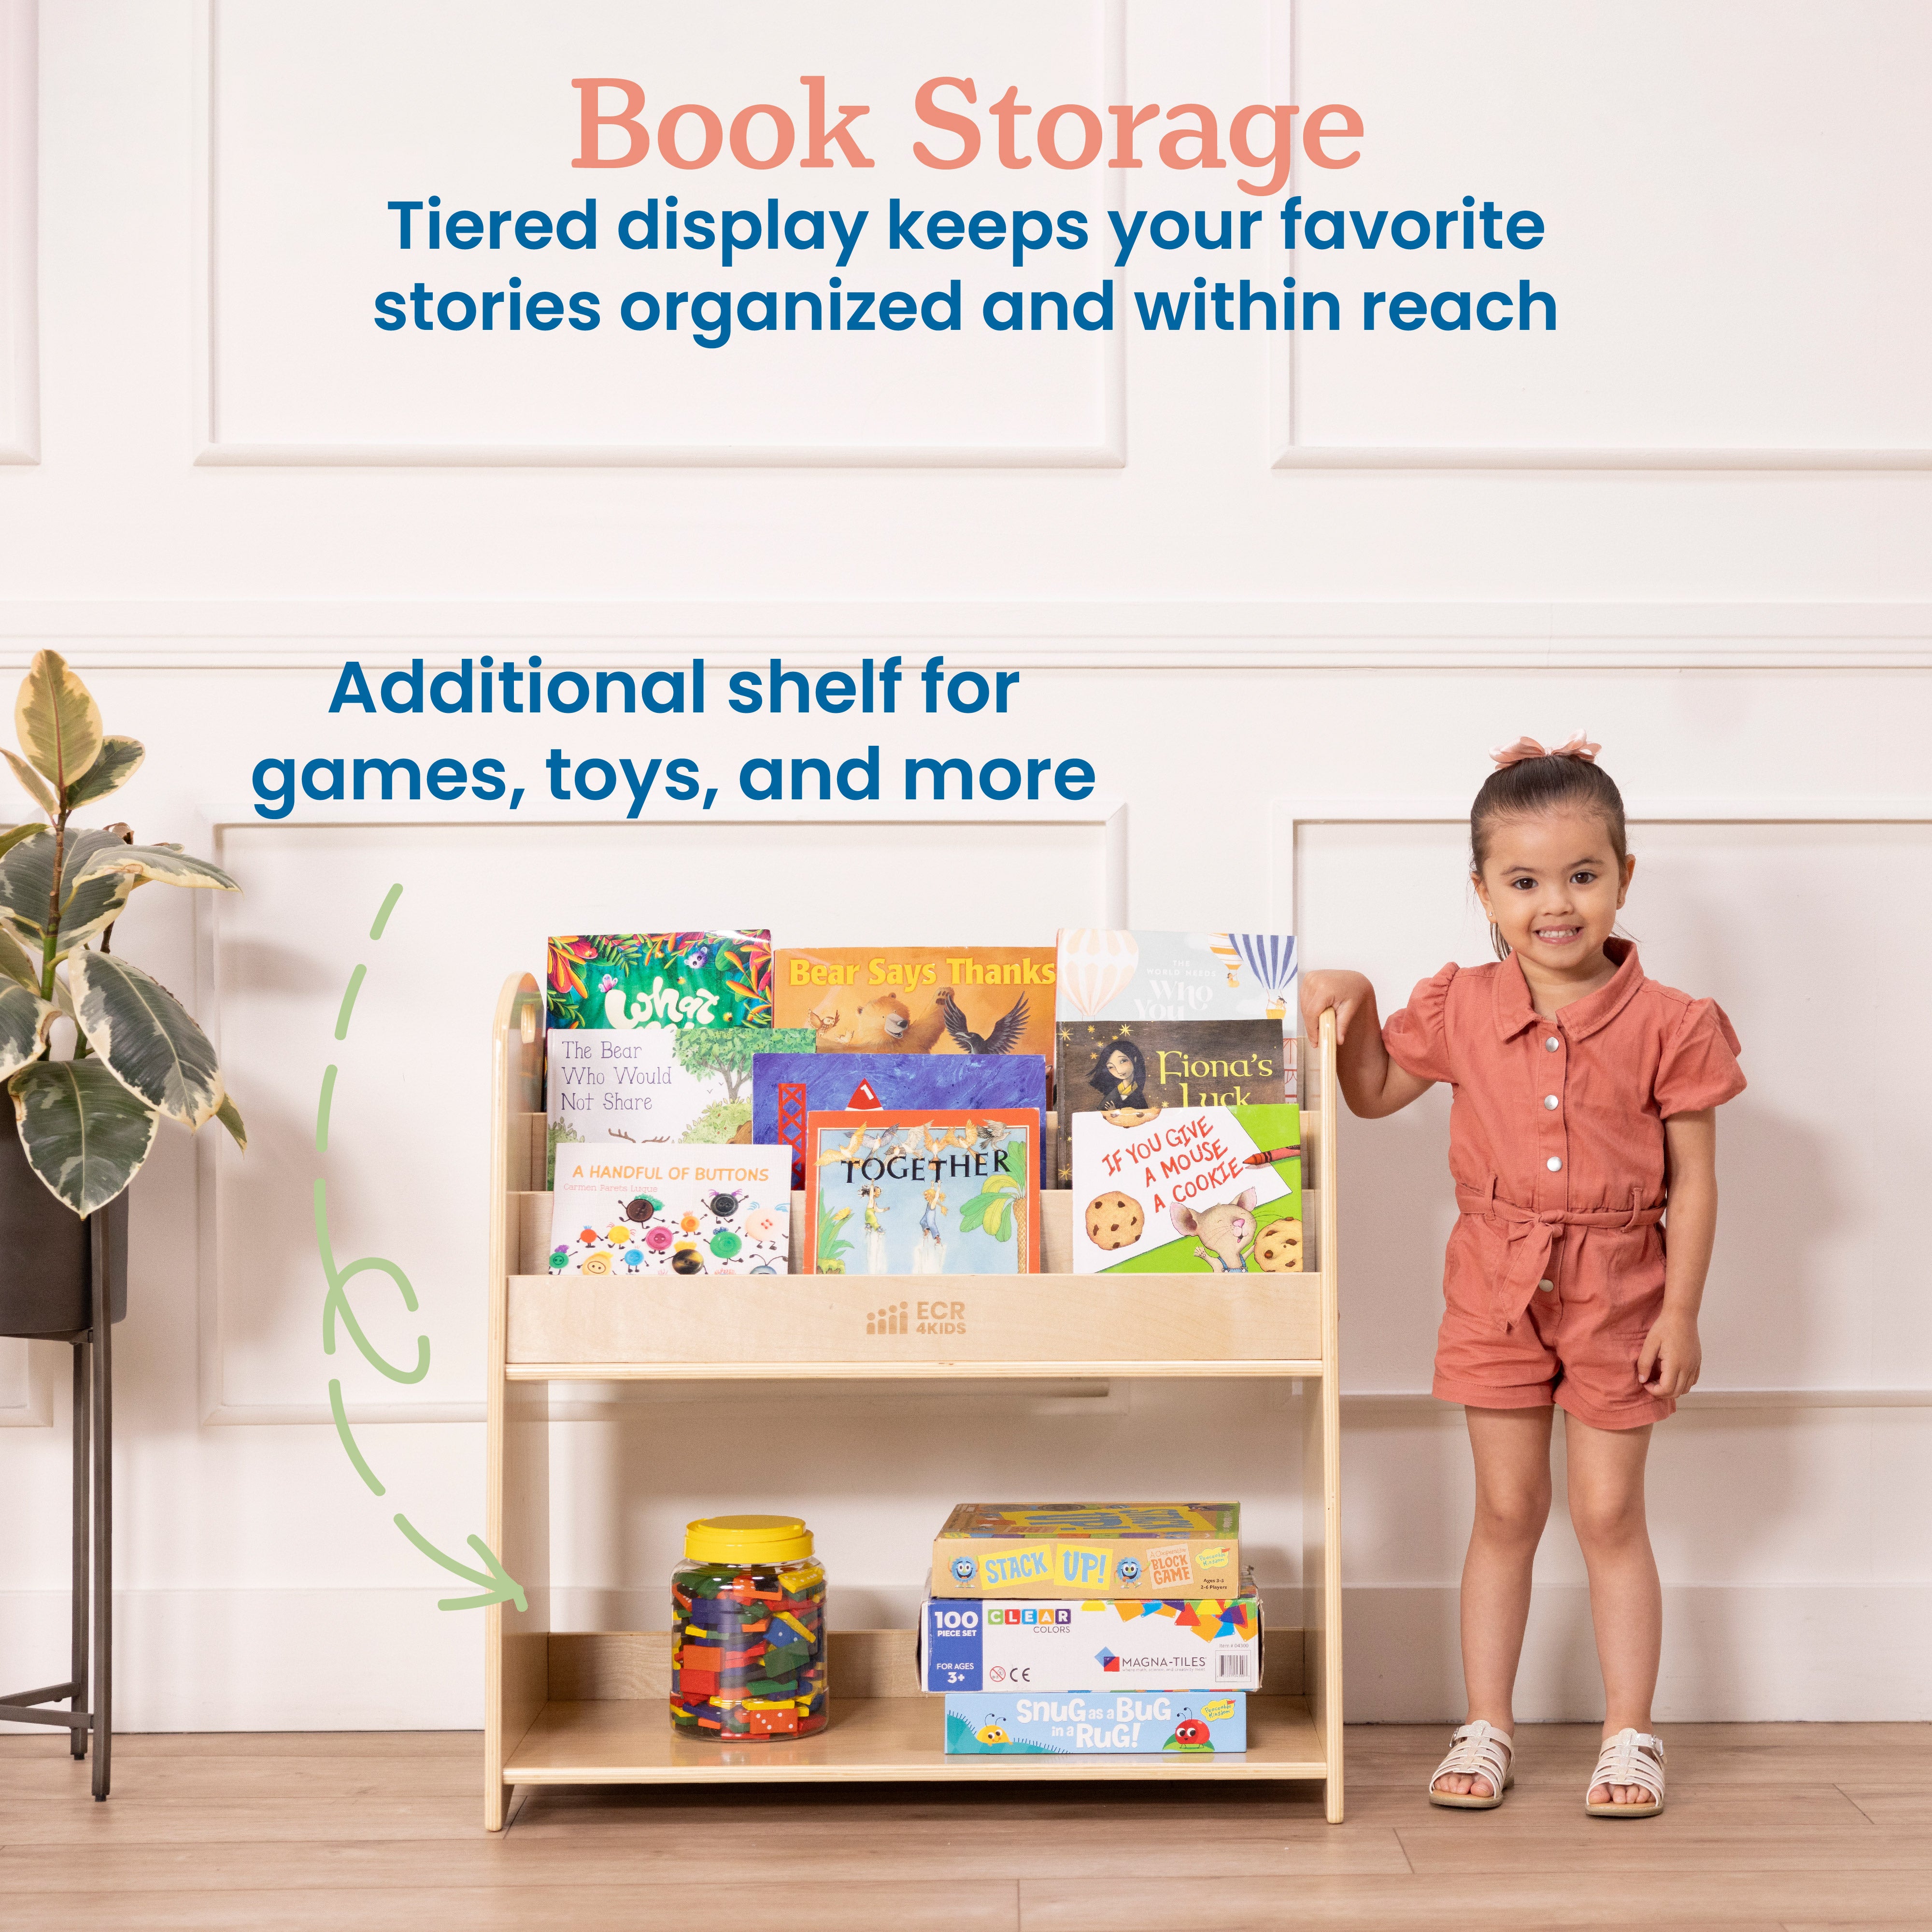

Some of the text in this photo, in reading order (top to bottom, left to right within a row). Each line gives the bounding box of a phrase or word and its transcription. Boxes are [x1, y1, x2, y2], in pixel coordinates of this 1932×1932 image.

[790, 957, 1056, 993] Bear Says Thanks
[1150, 980, 1213, 1010] Who
[1134, 999, 1184, 1021] You
[562, 1041, 642, 1059] The Bear
[562, 1066, 672, 1085] Who Would
[1156, 1051, 1273, 1085] Fiona's
[860, 1084, 874, 1100] 1
[561, 1093, 652, 1110] Not Share
[1102, 1116, 1213, 1177] IF YOU GIVE
[840, 1149, 1012, 1184] TOGETHER
[1145, 1138, 1228, 1188] A MOUSE
[573, 1165, 769, 1181] A HANDFUL OF BUTTONS
[564, 1183, 597, 1192] Carmen
[631, 1185, 658, 1193] Luque
[1153, 1157, 1244, 1213] A COOKIE
[918, 1301, 966, 1320] ECR
[916, 1322, 966, 1335] 4KIDS
[1156, 1548, 1186, 1556] Cooperative
[985, 1550, 1107, 1584] STACK UP!
[1151, 1554, 1188, 1570] BLOCK
[1153, 1566, 1190, 1585] GAME
[935, 1611, 979, 1629] 100
[990, 1610, 1068, 1623] CLEAR
[1122, 1657, 1206, 1667] MAGNA-TILES
[948, 1672, 965, 1683] 3+
[1016, 1697, 1171, 1723] SnuG as a BuG
[1205, 1704, 1232, 1713] Peaceable
[1208, 1710, 1230, 1718] Kingdom
[1052, 1726, 1063, 1736] in
[1066, 1728, 1074, 1737] a
